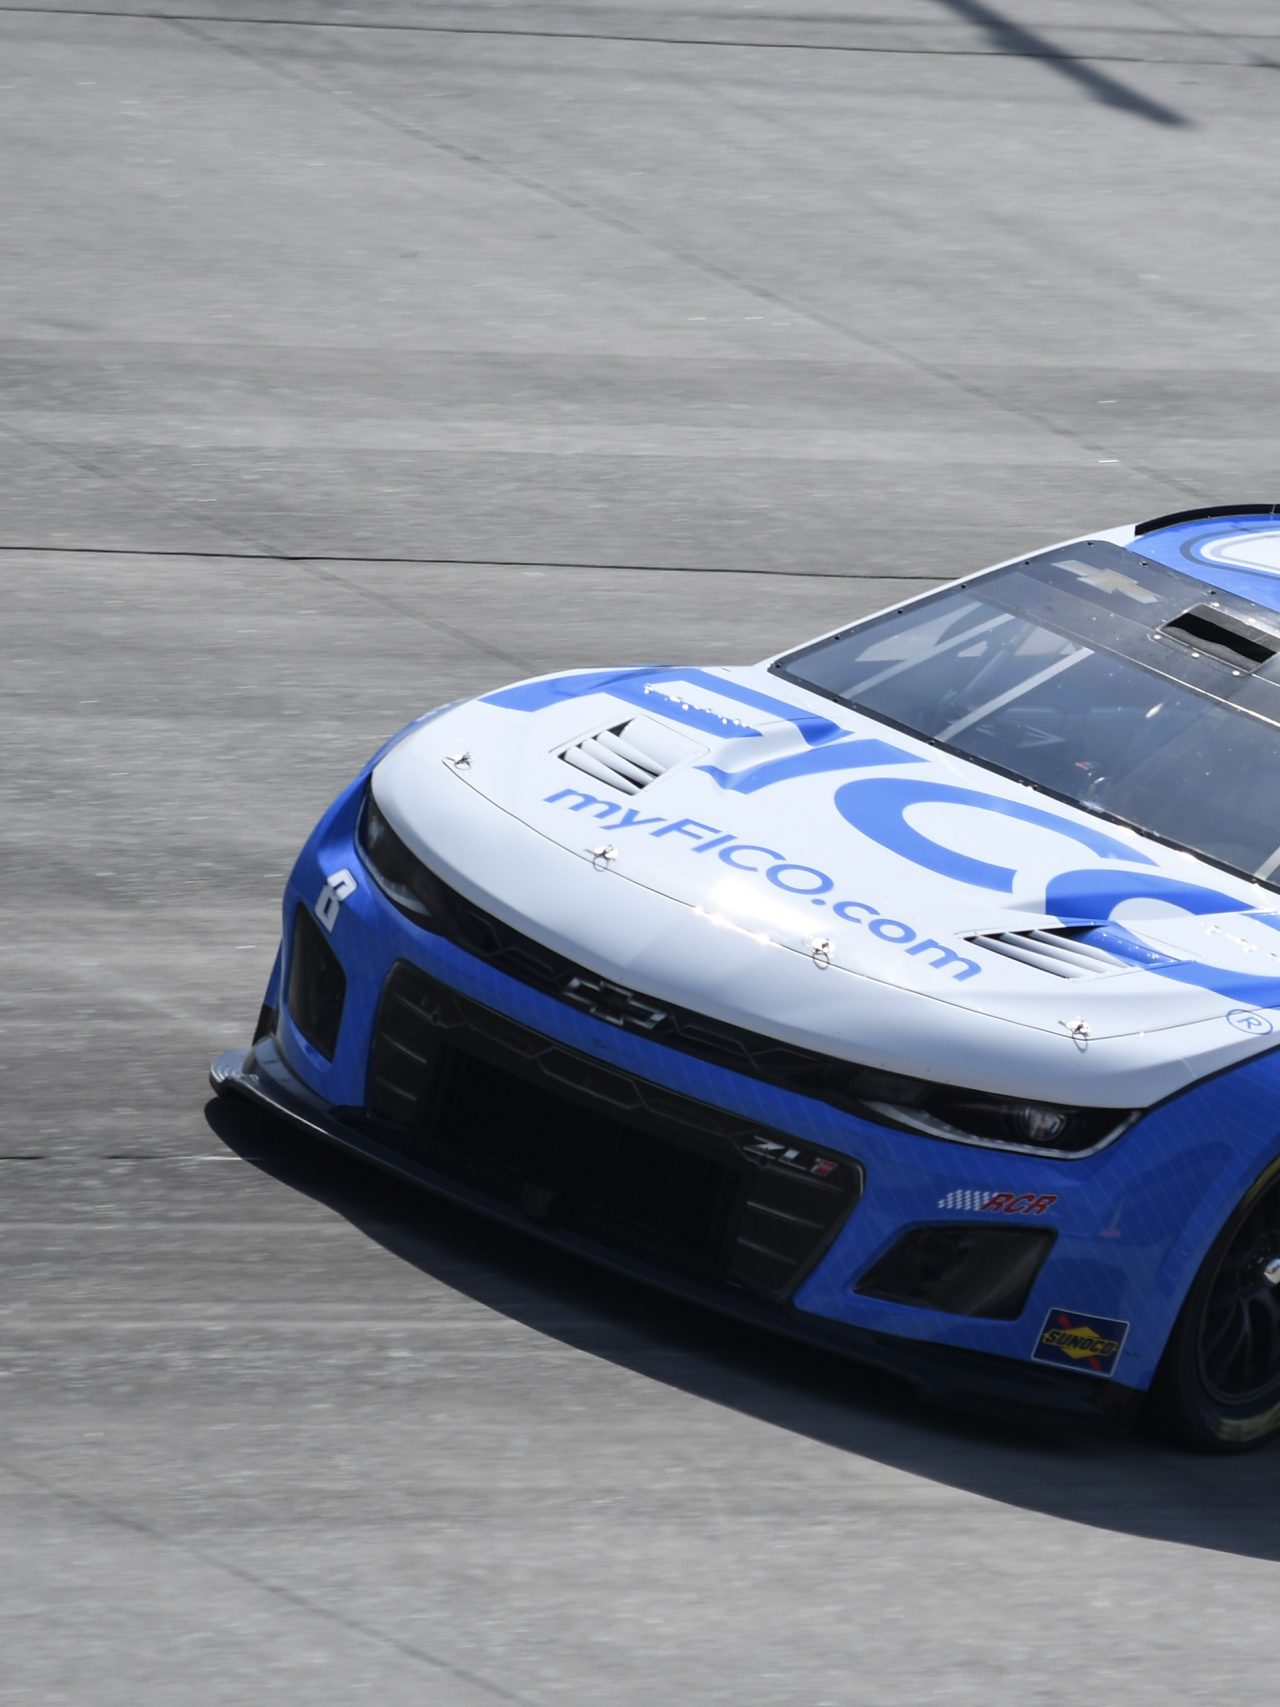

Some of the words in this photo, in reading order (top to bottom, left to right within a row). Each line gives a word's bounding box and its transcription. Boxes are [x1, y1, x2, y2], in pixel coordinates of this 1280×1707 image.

[544, 788, 983, 982] myFICO.com
[979, 1191, 1058, 1215] RCR
[1043, 1328, 1118, 1356] SUNOCO
